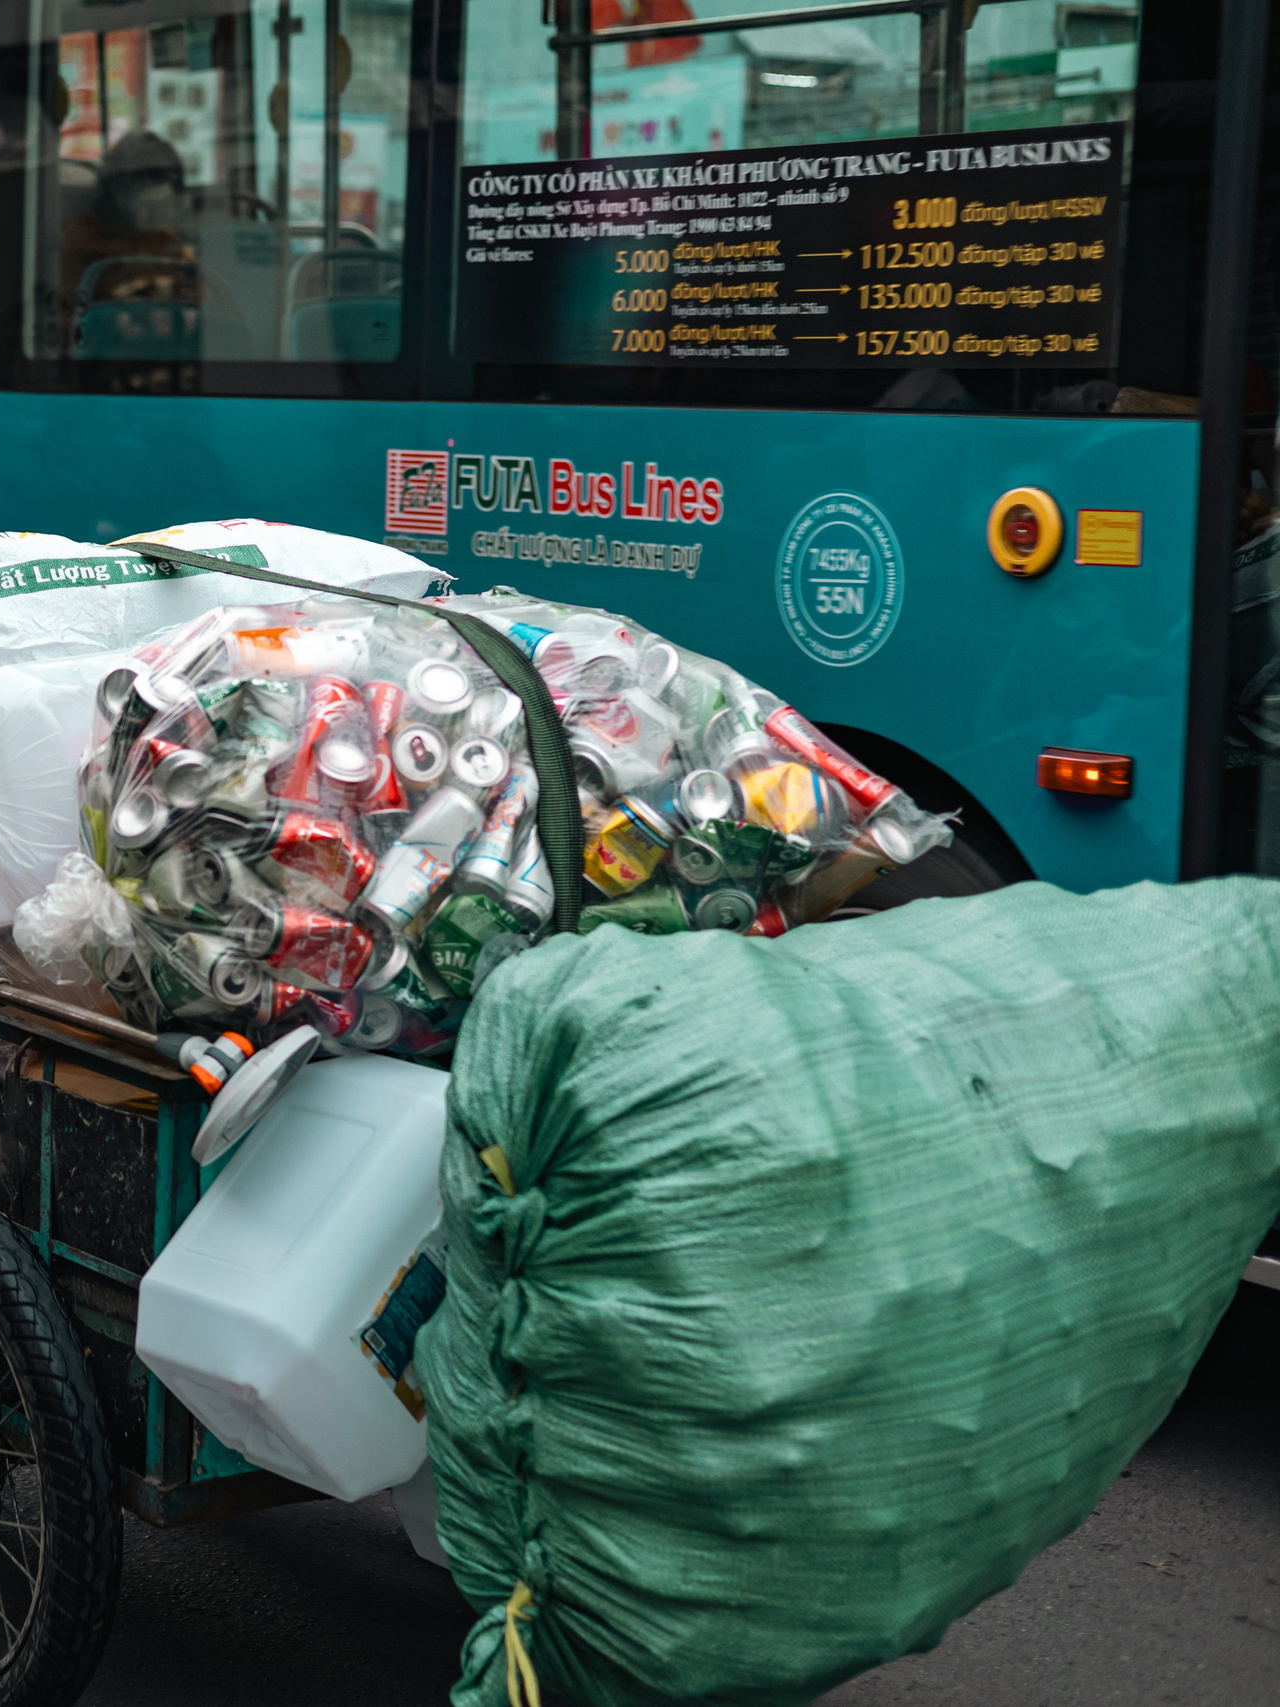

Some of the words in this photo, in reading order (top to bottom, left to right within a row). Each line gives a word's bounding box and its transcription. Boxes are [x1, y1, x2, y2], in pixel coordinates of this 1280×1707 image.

[468, 171, 519, 197] CÔNG
[521, 174, 547, 194] TY
[632, 168, 659, 189] XE
[662, 159, 736, 187] KHÁCH
[737, 156, 830, 183] PHƯƠNG
[831, 151, 911, 178] TRANG
[925, 146, 988, 172] FUTA
[892, 196, 956, 230] 3.000
[615, 250, 669, 273] 5.000
[860, 241, 954, 269] 112.500
[612, 289, 667, 312] 6.000
[857, 282, 952, 309] 135.000
[611, 329, 665, 352] 7.000
[855, 330, 949, 355] 157.500
[452, 454, 542, 513] FUTA
[548, 458, 617, 518] Bus
[621, 461, 723, 525] Lines
[472, 526, 517, 558] CHẤT
[517, 531, 582, 568] LƯỢNG
[584, 534, 609, 566] LÀ
[610, 540, 667, 570] DANH
[669, 543, 703, 579] DỰ
[32, 564, 111, 584] Lượng
[816, 586, 865, 615] 55N
